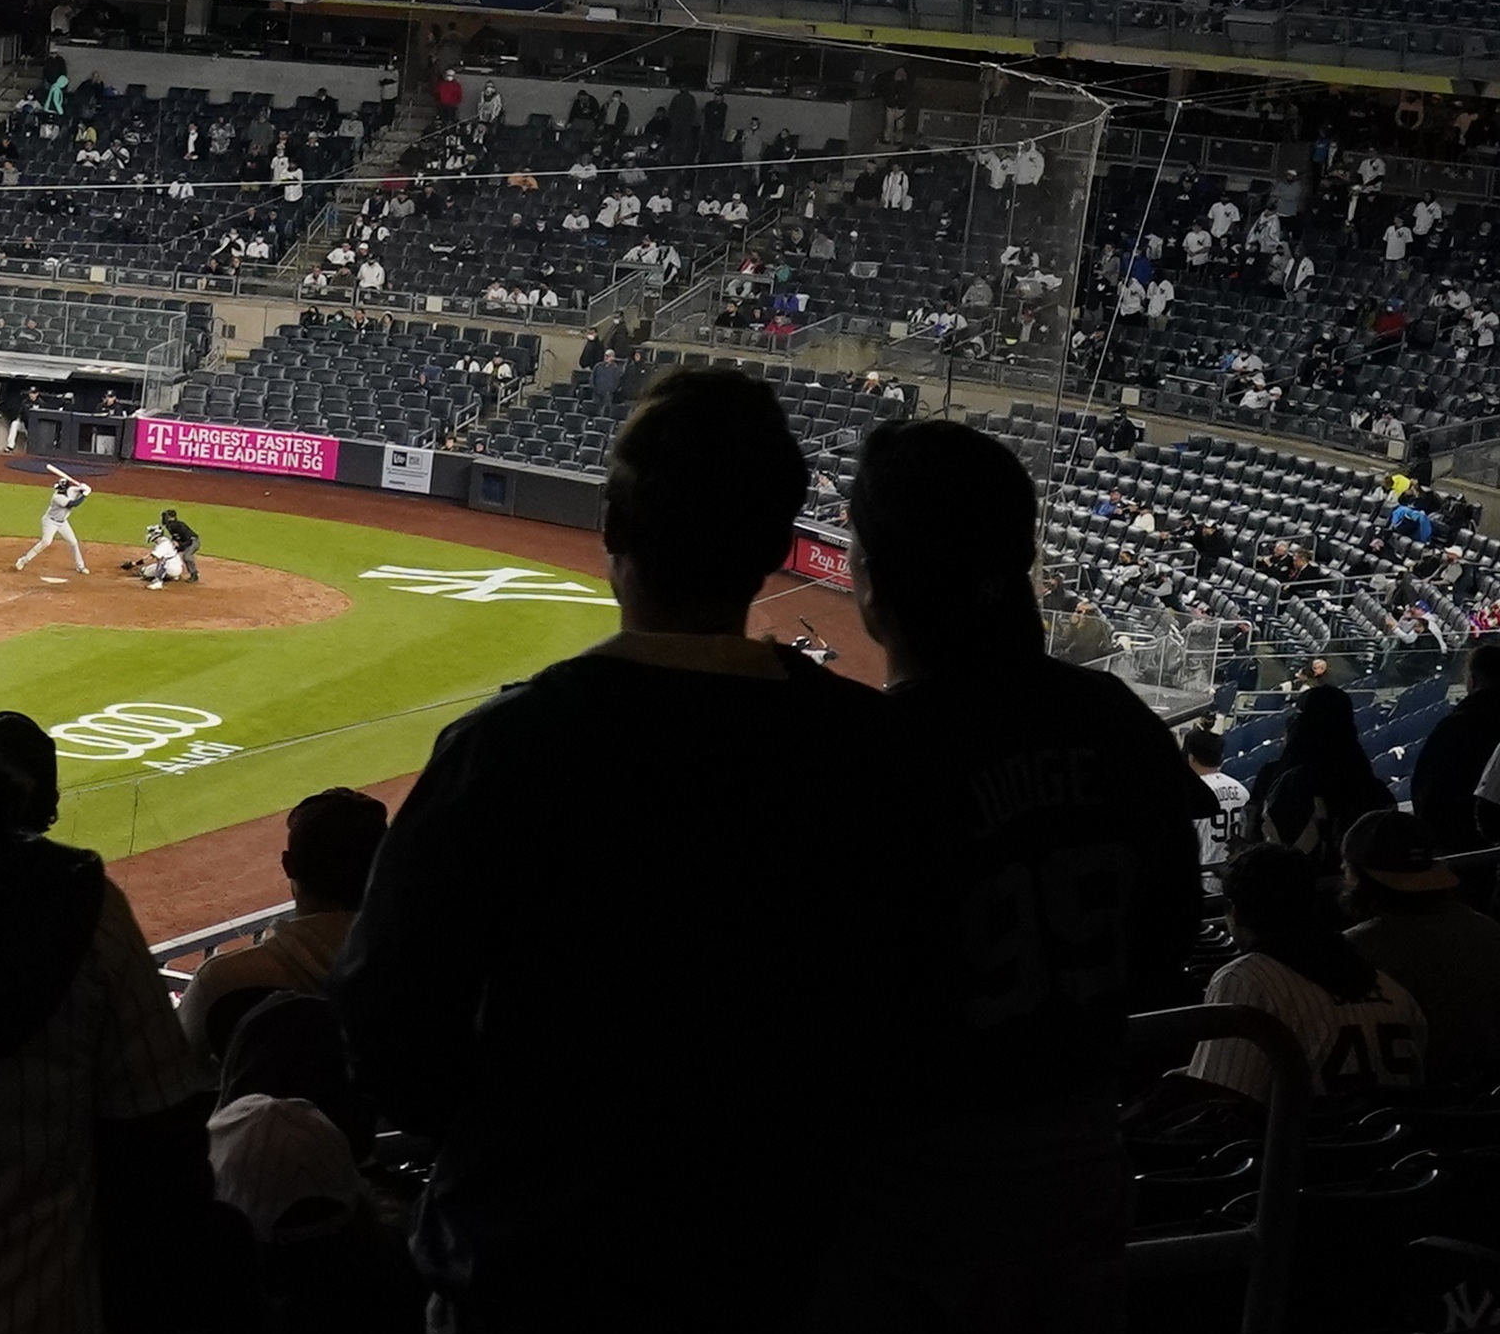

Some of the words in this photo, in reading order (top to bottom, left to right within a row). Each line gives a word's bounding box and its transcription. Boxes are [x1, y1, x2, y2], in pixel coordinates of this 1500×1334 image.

[178, 427, 253, 448] LARGEST.
[257, 431, 324, 457] FASTEST.
[178, 442, 203, 459] THE
[204, 444, 279, 465] LEADER
[282, 452, 299, 468] IN
[301, 454, 324, 471] 5G
[809, 545, 836, 572] Pep
[142, 740, 244, 775] Audi
[963, 840, 1140, 1031] 99
[1321, 1022, 1418, 1091] 45
